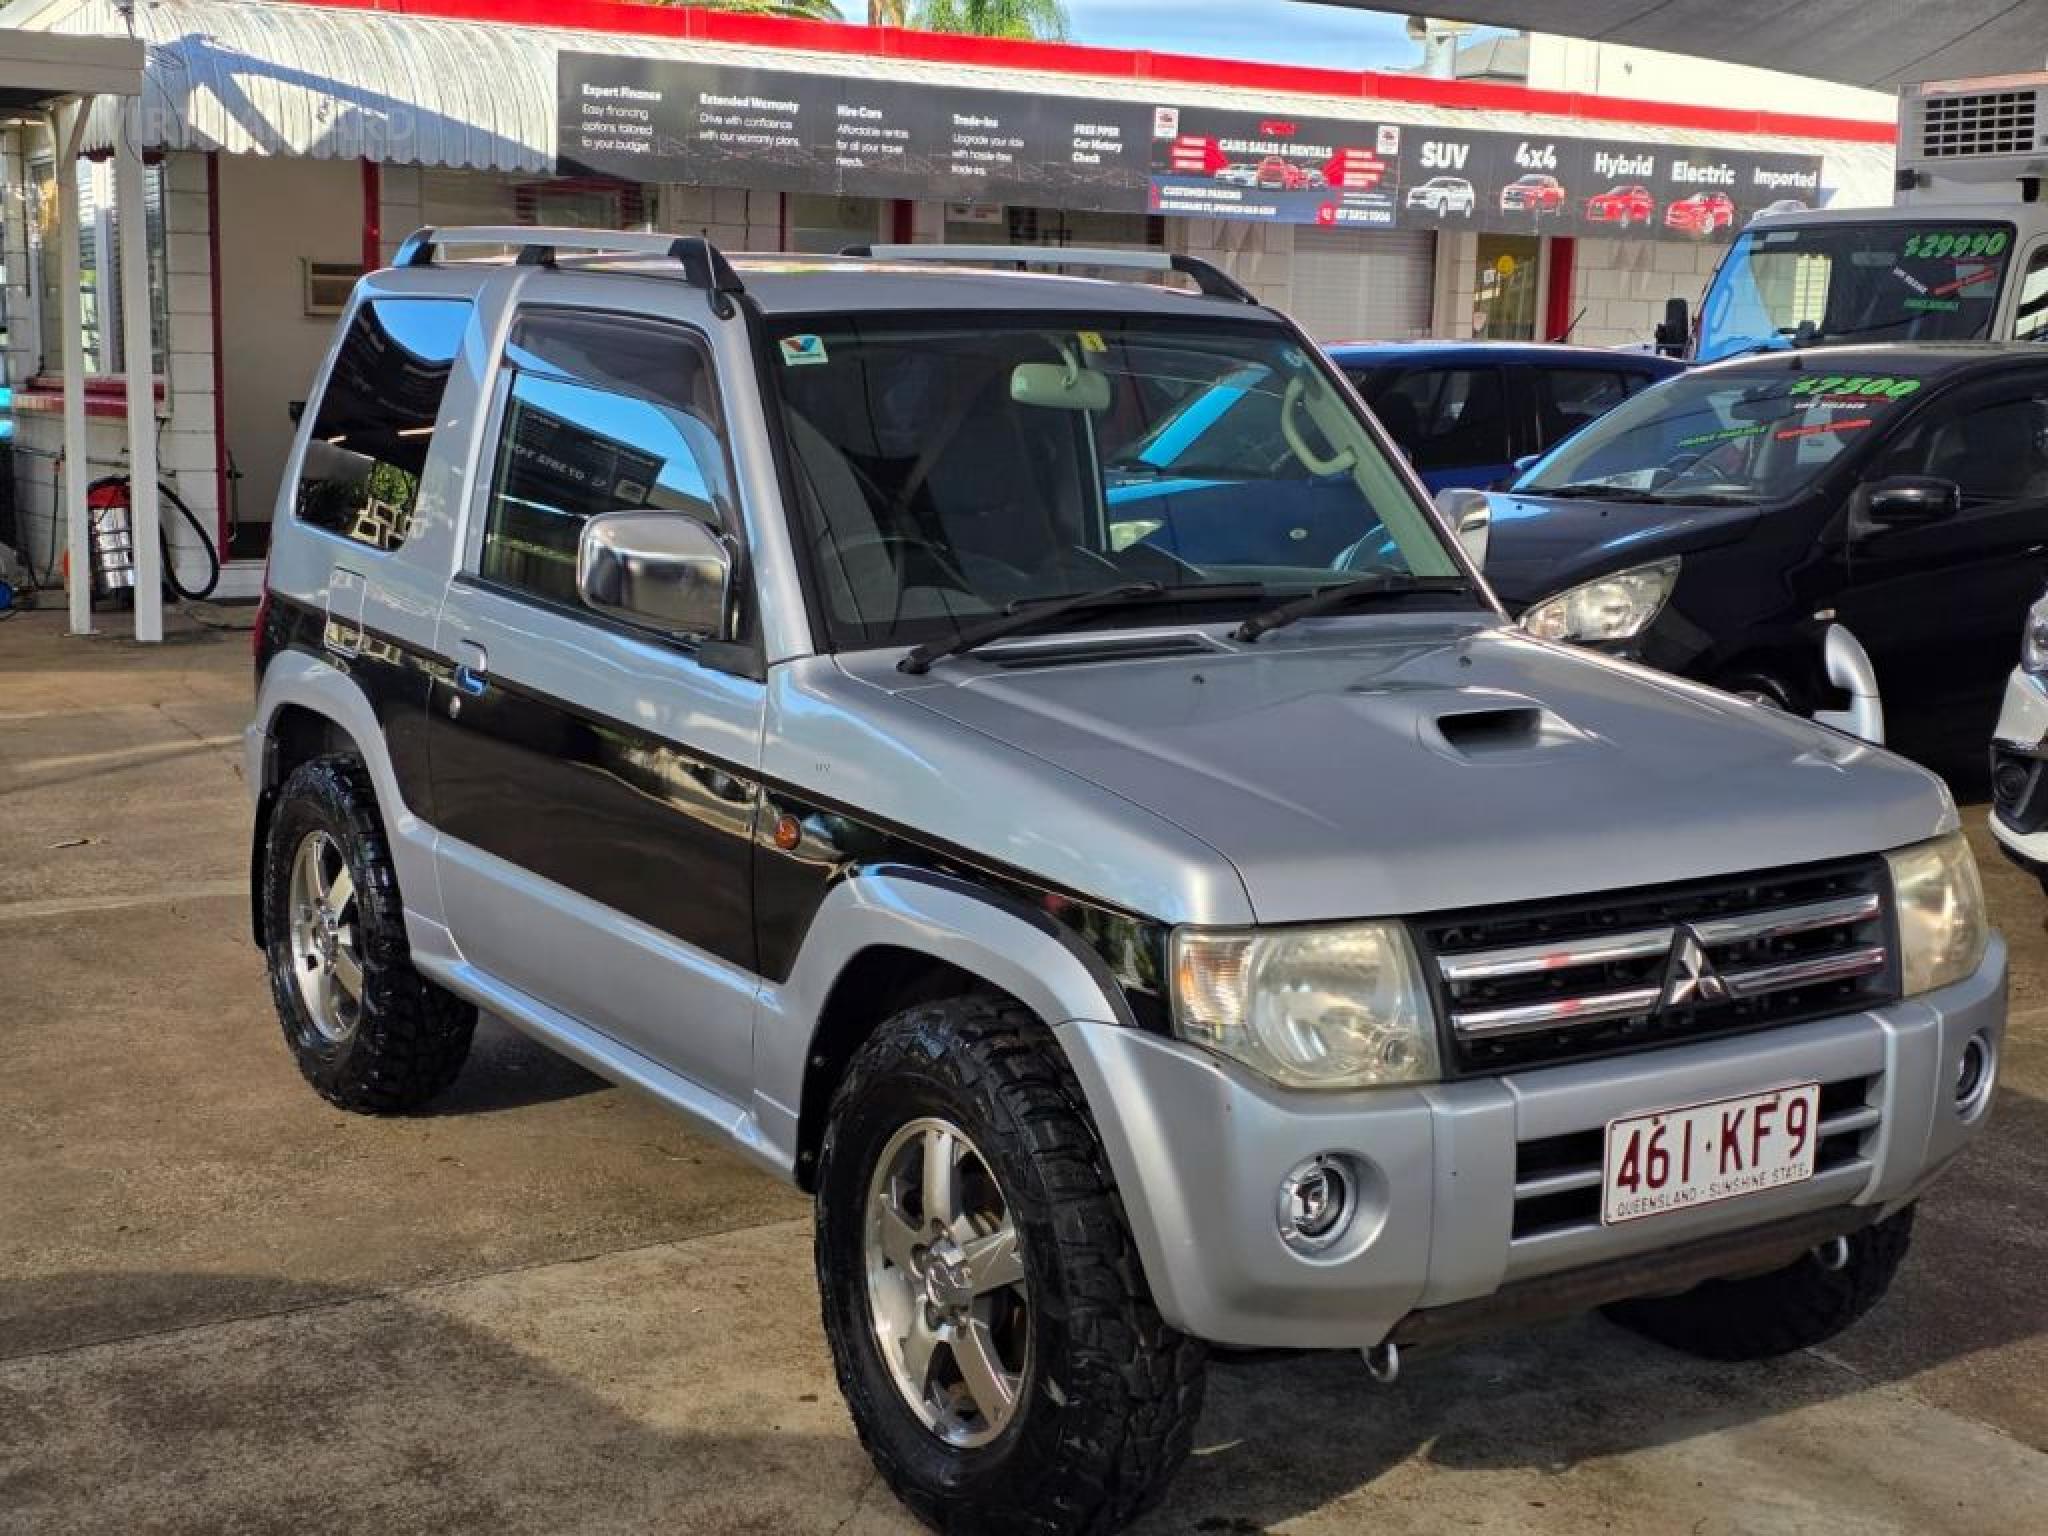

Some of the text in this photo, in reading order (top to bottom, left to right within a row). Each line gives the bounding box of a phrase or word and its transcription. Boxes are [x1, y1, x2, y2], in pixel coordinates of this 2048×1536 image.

[582, 83, 662, 101] Expert Finance
[700, 92, 800, 113] Extended Warranty
[582, 104, 648, 121] Easy financing
[837, 104, 882, 120] Hire Cars
[617, 123, 652, 136] tailored
[700, 112, 793, 130] Drive with confidence
[700, 130, 719, 142] with
[720, 132, 735, 142] our
[736, 133, 774, 147] warranty
[837, 124, 880, 139] Affordable
[582, 138, 594, 148] to
[594, 140, 614, 152] your
[836, 141, 848, 152] for
[850, 141, 860, 152] all
[861, 142, 879, 155] your
[953, 133, 989, 148] Upgrade
[990, 137, 1008, 149] your
[1073, 138, 1089, 151] Car
[952, 148, 971, 160] with
[1421, 142, 1470, 169] SUV
[1515, 143, 1557, 169] 4x4
[1595, 152, 1654, 178] Hybrid
[1672, 160, 1737, 186] Electric
[1754, 166, 1817, 189] Imported
[1904, 231, 2007, 258] $29990
[1789, 377, 1921, 400] $7500
[1616, 1186, 1697, 1217] QUEENSLAND
[1709, 1171, 1766, 1198] SUNSHINE
[1771, 1162, 1806, 1184] STATE
